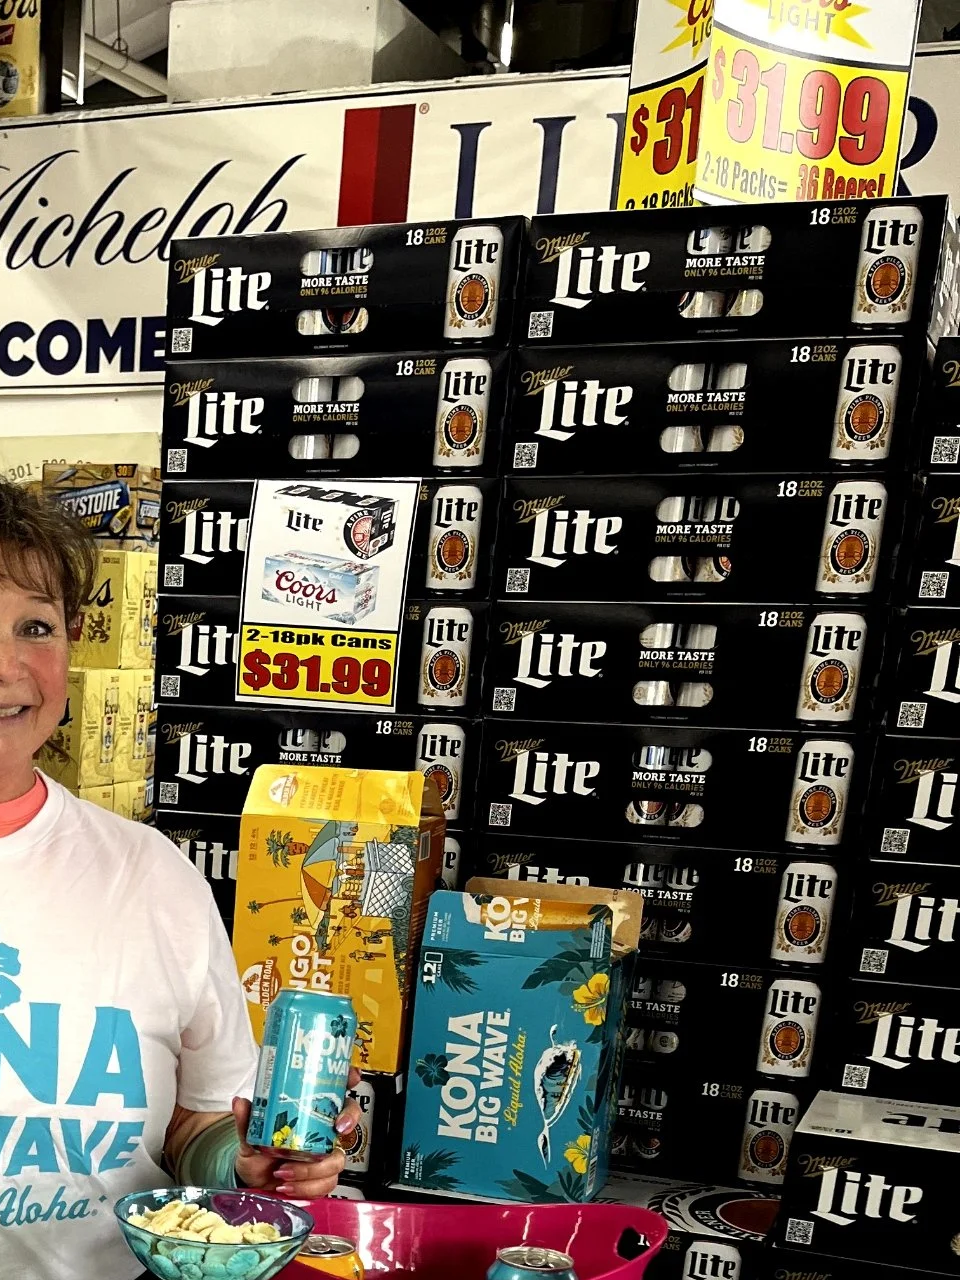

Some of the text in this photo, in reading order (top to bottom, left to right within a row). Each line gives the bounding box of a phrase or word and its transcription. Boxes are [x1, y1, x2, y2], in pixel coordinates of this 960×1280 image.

[767, 3, 836, 34] LIGHT
[710, 46, 890, 166] $31.99
[702, 150, 728, 183] 2-18
[796, 163, 818, 201] 36
[823, 168, 886, 200] Beers!
[810, 207, 830, 225] 18
[405, 229, 424, 246] 18
[536, 231, 591, 264] Miller
[864, 219, 918, 254] Lite
[174, 253, 221, 284] Miller
[453, 238, 499, 273] Lite
[685, 256, 765, 268] MORE TASTE
[330, 284, 368, 294] CALORIES
[335, 275, 369, 286] TASTE
[549, 246, 651, 309] Lite
[188, 266, 272, 326] Lite
[442, 370, 487, 403] Lite
[521, 365, 575, 396] Miller
[844, 357, 897, 392] Lite
[183, 391, 265, 449] Lite
[293, 403, 324, 415] MORE
[534, 380, 633, 442] Lite
[116, 466, 129, 476] 30
[165, 496, 210, 524] Miller
[286, 509, 323, 532] Lite
[434, 497, 479, 528] Lite
[829, 493, 882, 526] Lite
[526, 509, 623, 568] Lite
[275, 569, 337, 604] Coors
[286, 594, 322, 612] LIGHT
[246, 629, 392, 650] 2-18pk Cans
[810, 624, 862, 657] Lite
[243, 649, 391, 698] $31.99
[513, 632, 607, 688] Lite
[174, 735, 252, 784] Lite
[279, 752, 342, 764] MORE TASTE
[419, 733, 461, 760] Lite
[508, 752, 600, 805] Lite
[894, 757, 954, 783] Miller
[430, 911, 438, 941] PREMIUM
[263, 959, 274, 983] ROAD
[423, 963, 436, 983] 12
[437, 1011, 484, 1140] KONA
[475, 1011, 510, 1144] BIG WAVE
[504, 1032, 526, 1127] Liquid Aloha
[404, 1151, 412, 1179] PREMIUM
[798, 1154, 857, 1177] Miller
[809, 1166, 923, 1226] Lite
[687, 1251, 736, 1280] Lite
